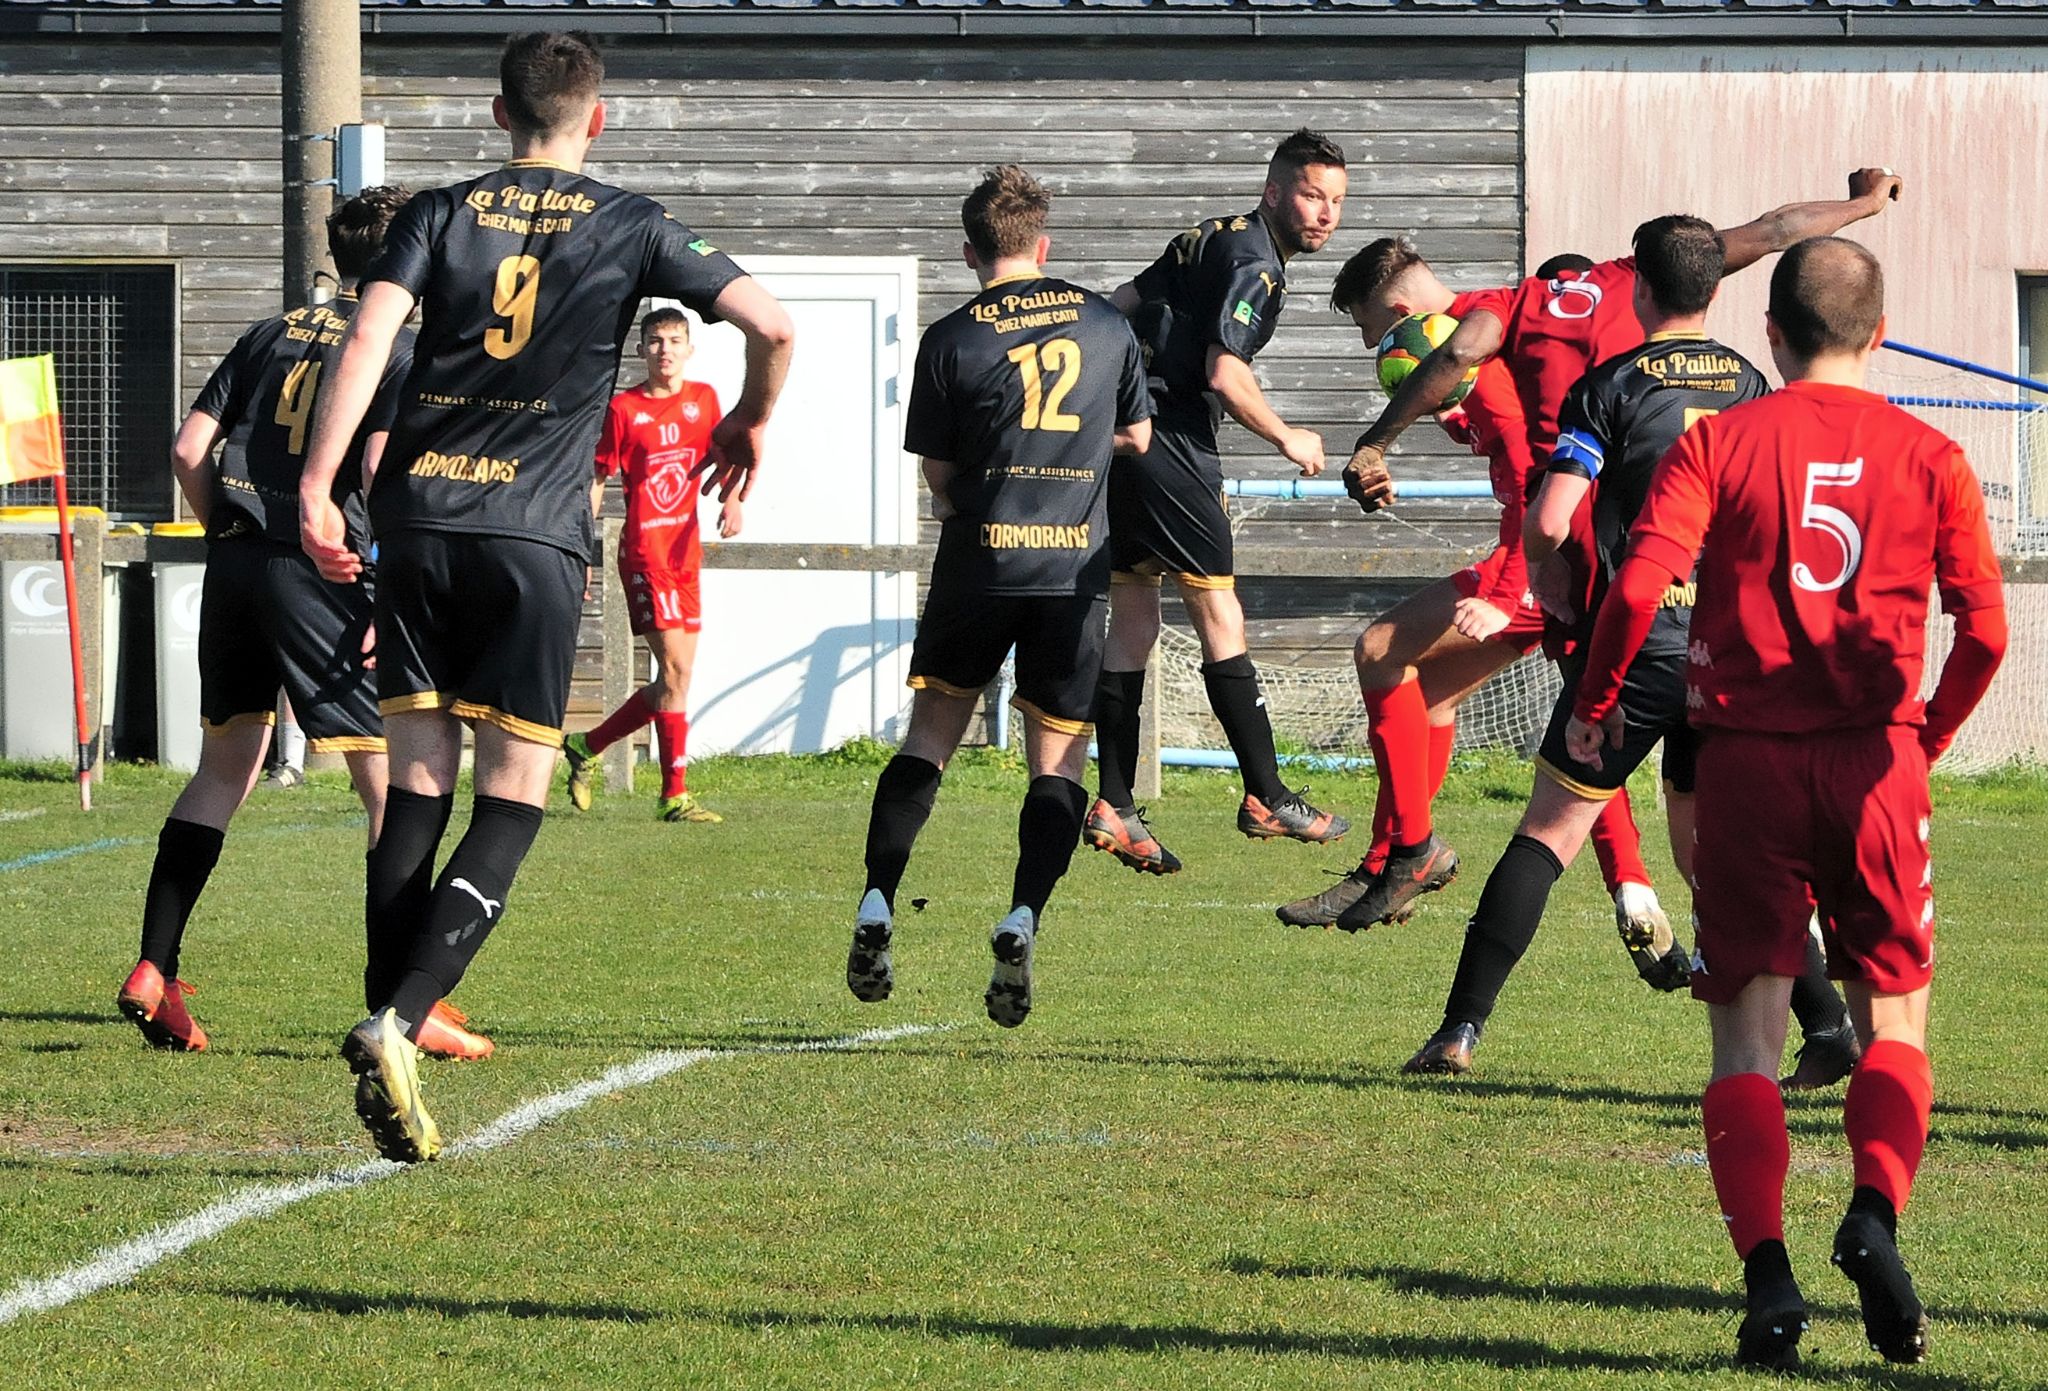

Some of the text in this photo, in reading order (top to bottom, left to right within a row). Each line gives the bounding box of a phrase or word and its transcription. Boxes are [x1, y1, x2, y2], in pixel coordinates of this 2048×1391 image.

[465, 187, 495, 212] La
[477, 213, 507, 231] CHEZ
[543, 217, 572, 234] CATH
[484, 254, 542, 361] 9
[969, 289, 1086, 323] La Paillote
[994, 308, 1079, 334] CHEZ MARIE CATH
[1635, 352, 1742, 379] La Paillote
[1006, 337, 1081, 433] 12
[273, 359, 322, 456] 4
[658, 422, 680, 446] 10
[1039, 467, 1095, 479] ASSISTANCE
[979, 523, 1090, 550] CORMORANS
[1791, 456, 1864, 593] 5
